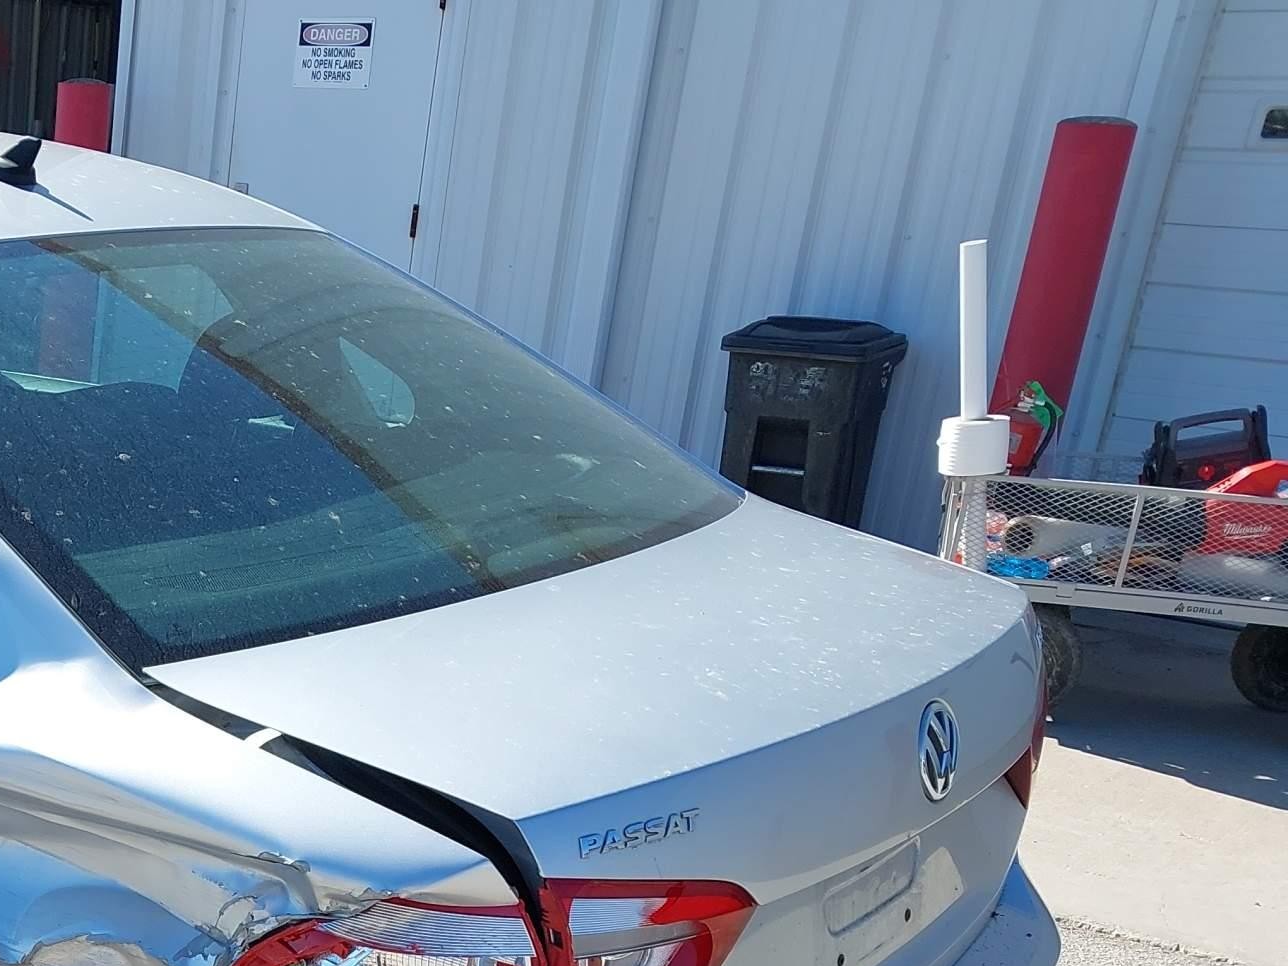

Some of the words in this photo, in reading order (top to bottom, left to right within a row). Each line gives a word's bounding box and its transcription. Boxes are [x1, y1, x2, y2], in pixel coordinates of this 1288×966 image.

[310, 28, 360, 40] DANGER
[311, 48, 321, 57] NO
[323, 48, 355, 57] SMOKING
[302, 59, 312, 68] NO
[314, 59, 333, 68] OPEN
[334, 60, 363, 69] FLAMES
[311, 70, 321, 80] NO
[323, 71, 351, 80] SPARKS
[1186, 605, 1223, 615] GORILLA
[578, 808, 700, 859] PASSAT
